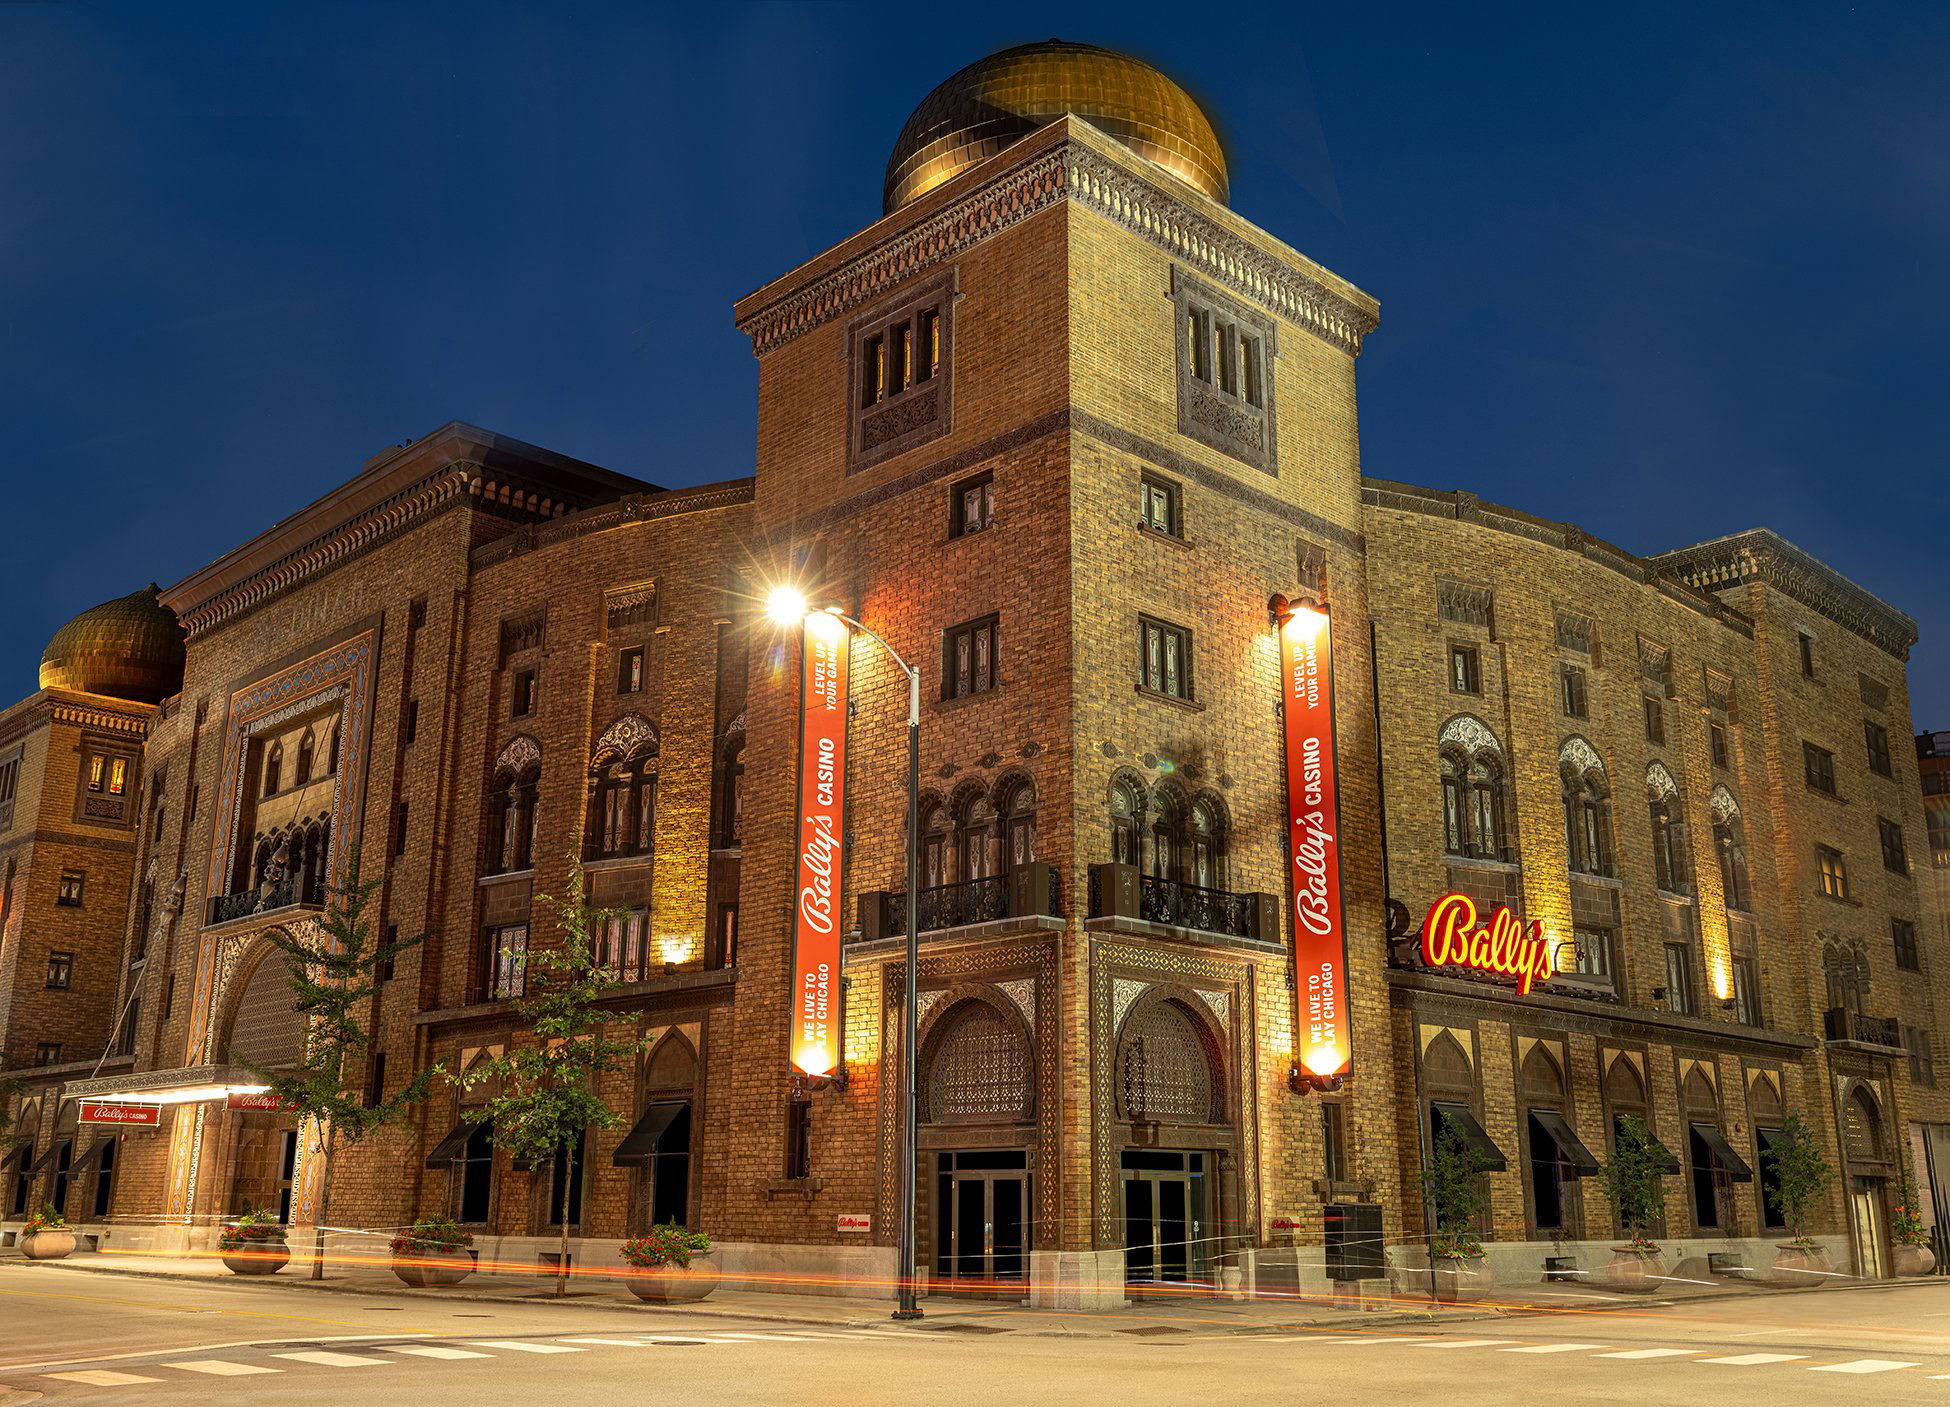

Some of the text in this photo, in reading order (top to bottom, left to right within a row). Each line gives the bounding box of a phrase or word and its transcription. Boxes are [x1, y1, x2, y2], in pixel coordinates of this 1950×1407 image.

[815, 641, 827, 696] LEVEL UP
[826, 680, 837, 711] YOUR
[1293, 645, 1306, 698] LEVEL UP
[1306, 677, 1319, 710] YOUR
[801, 738, 840, 934] Bally's CASINO
[1296, 737, 1334, 936] Bally's CASINO
[1421, 893, 1553, 996] Bally's
[803, 973, 817, 1041] WE LIVE TO
[816, 963, 829, 1051] LAY CHICAGO
[1308, 974, 1323, 1044] WE LIVE TO
[1321, 962, 1337, 1051] LAY CHICAGO
[93, 1106, 148, 1121] Bally's CASINO
[241, 1095, 276, 1110] Bally's
